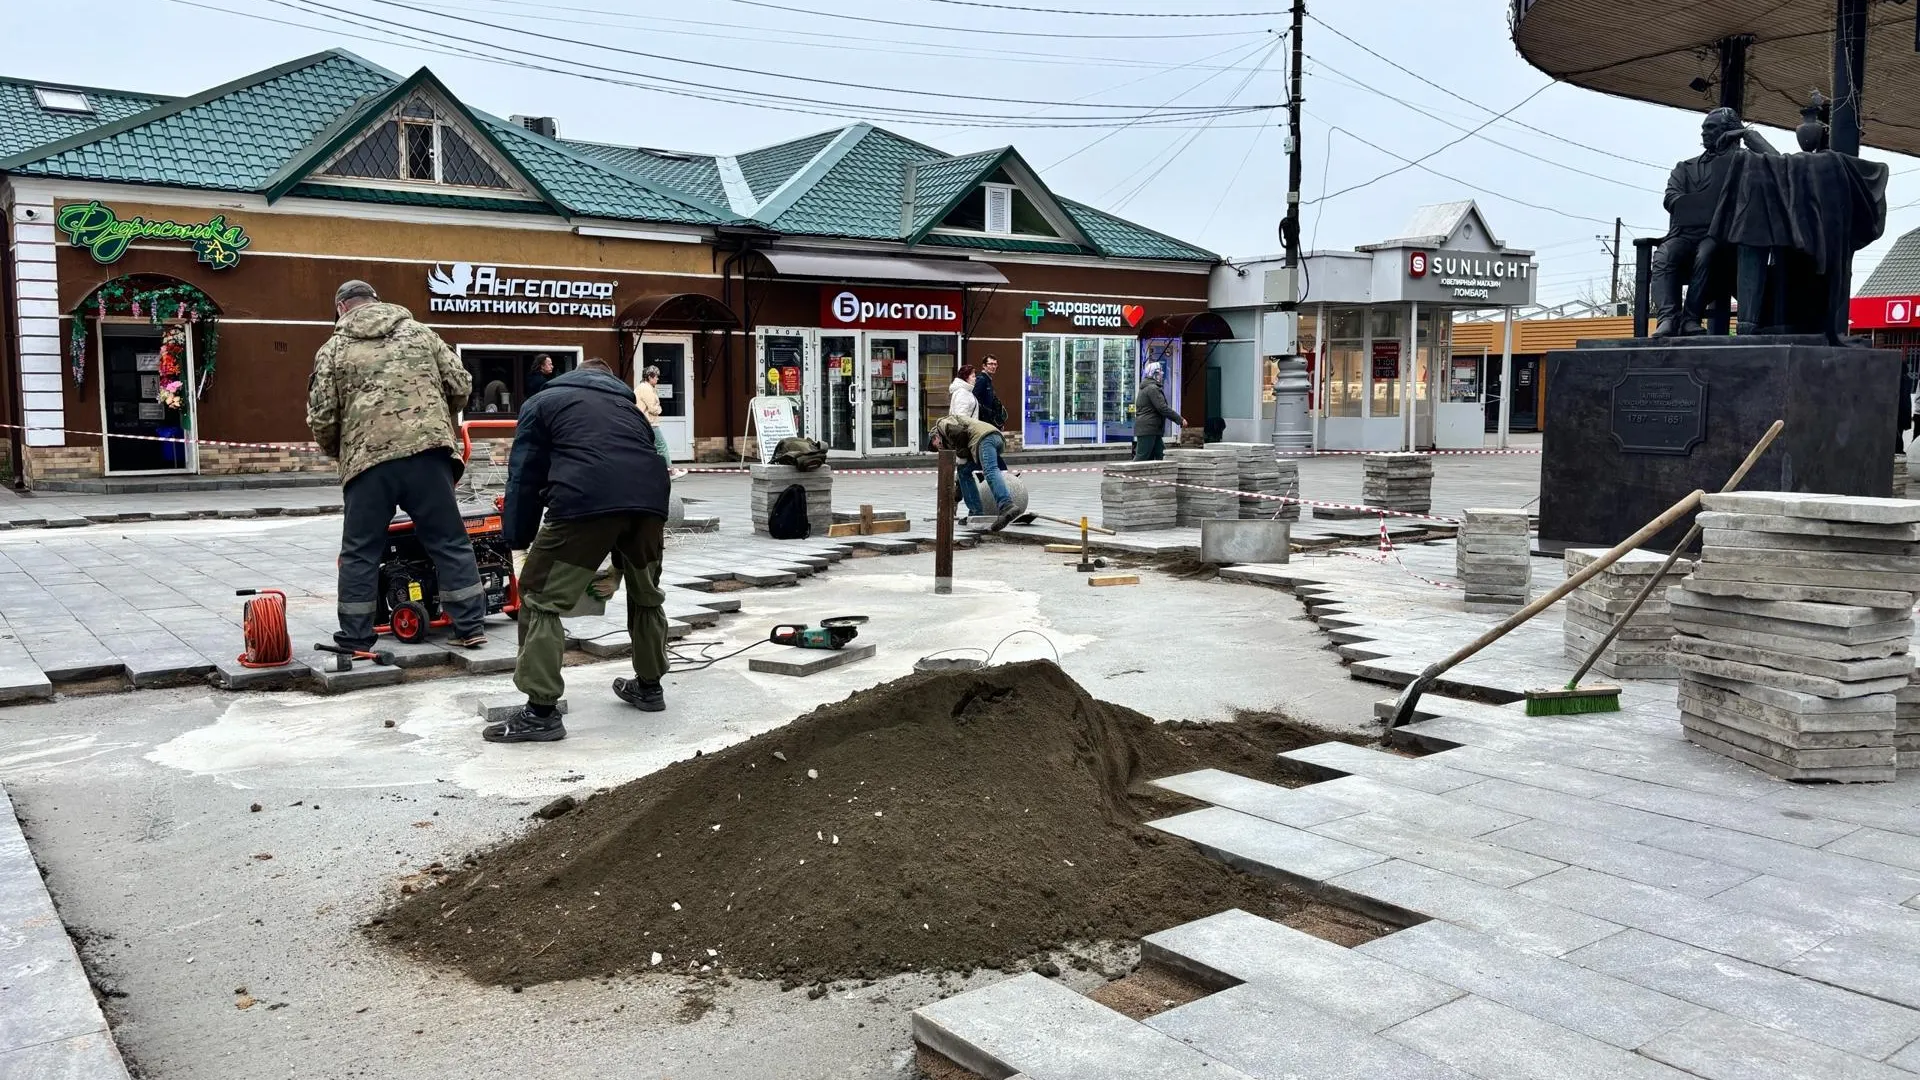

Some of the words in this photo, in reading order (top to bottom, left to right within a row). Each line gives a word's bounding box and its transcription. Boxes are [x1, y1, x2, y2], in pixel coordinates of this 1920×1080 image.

[58, 201, 248, 262] Флористика
[1433, 257, 1530, 278] SUNLIGHT
[1453, 287, 1489, 299] ЛОМБАРД
[430, 298, 540, 314] ПАМЯТНИКИ
[549, 301, 616, 318] ОГРАДЫ
[839, 295, 957, 322] Бристоль
[1047, 301, 1121, 317] здравсити
[1073, 315, 1121, 327] аптека
